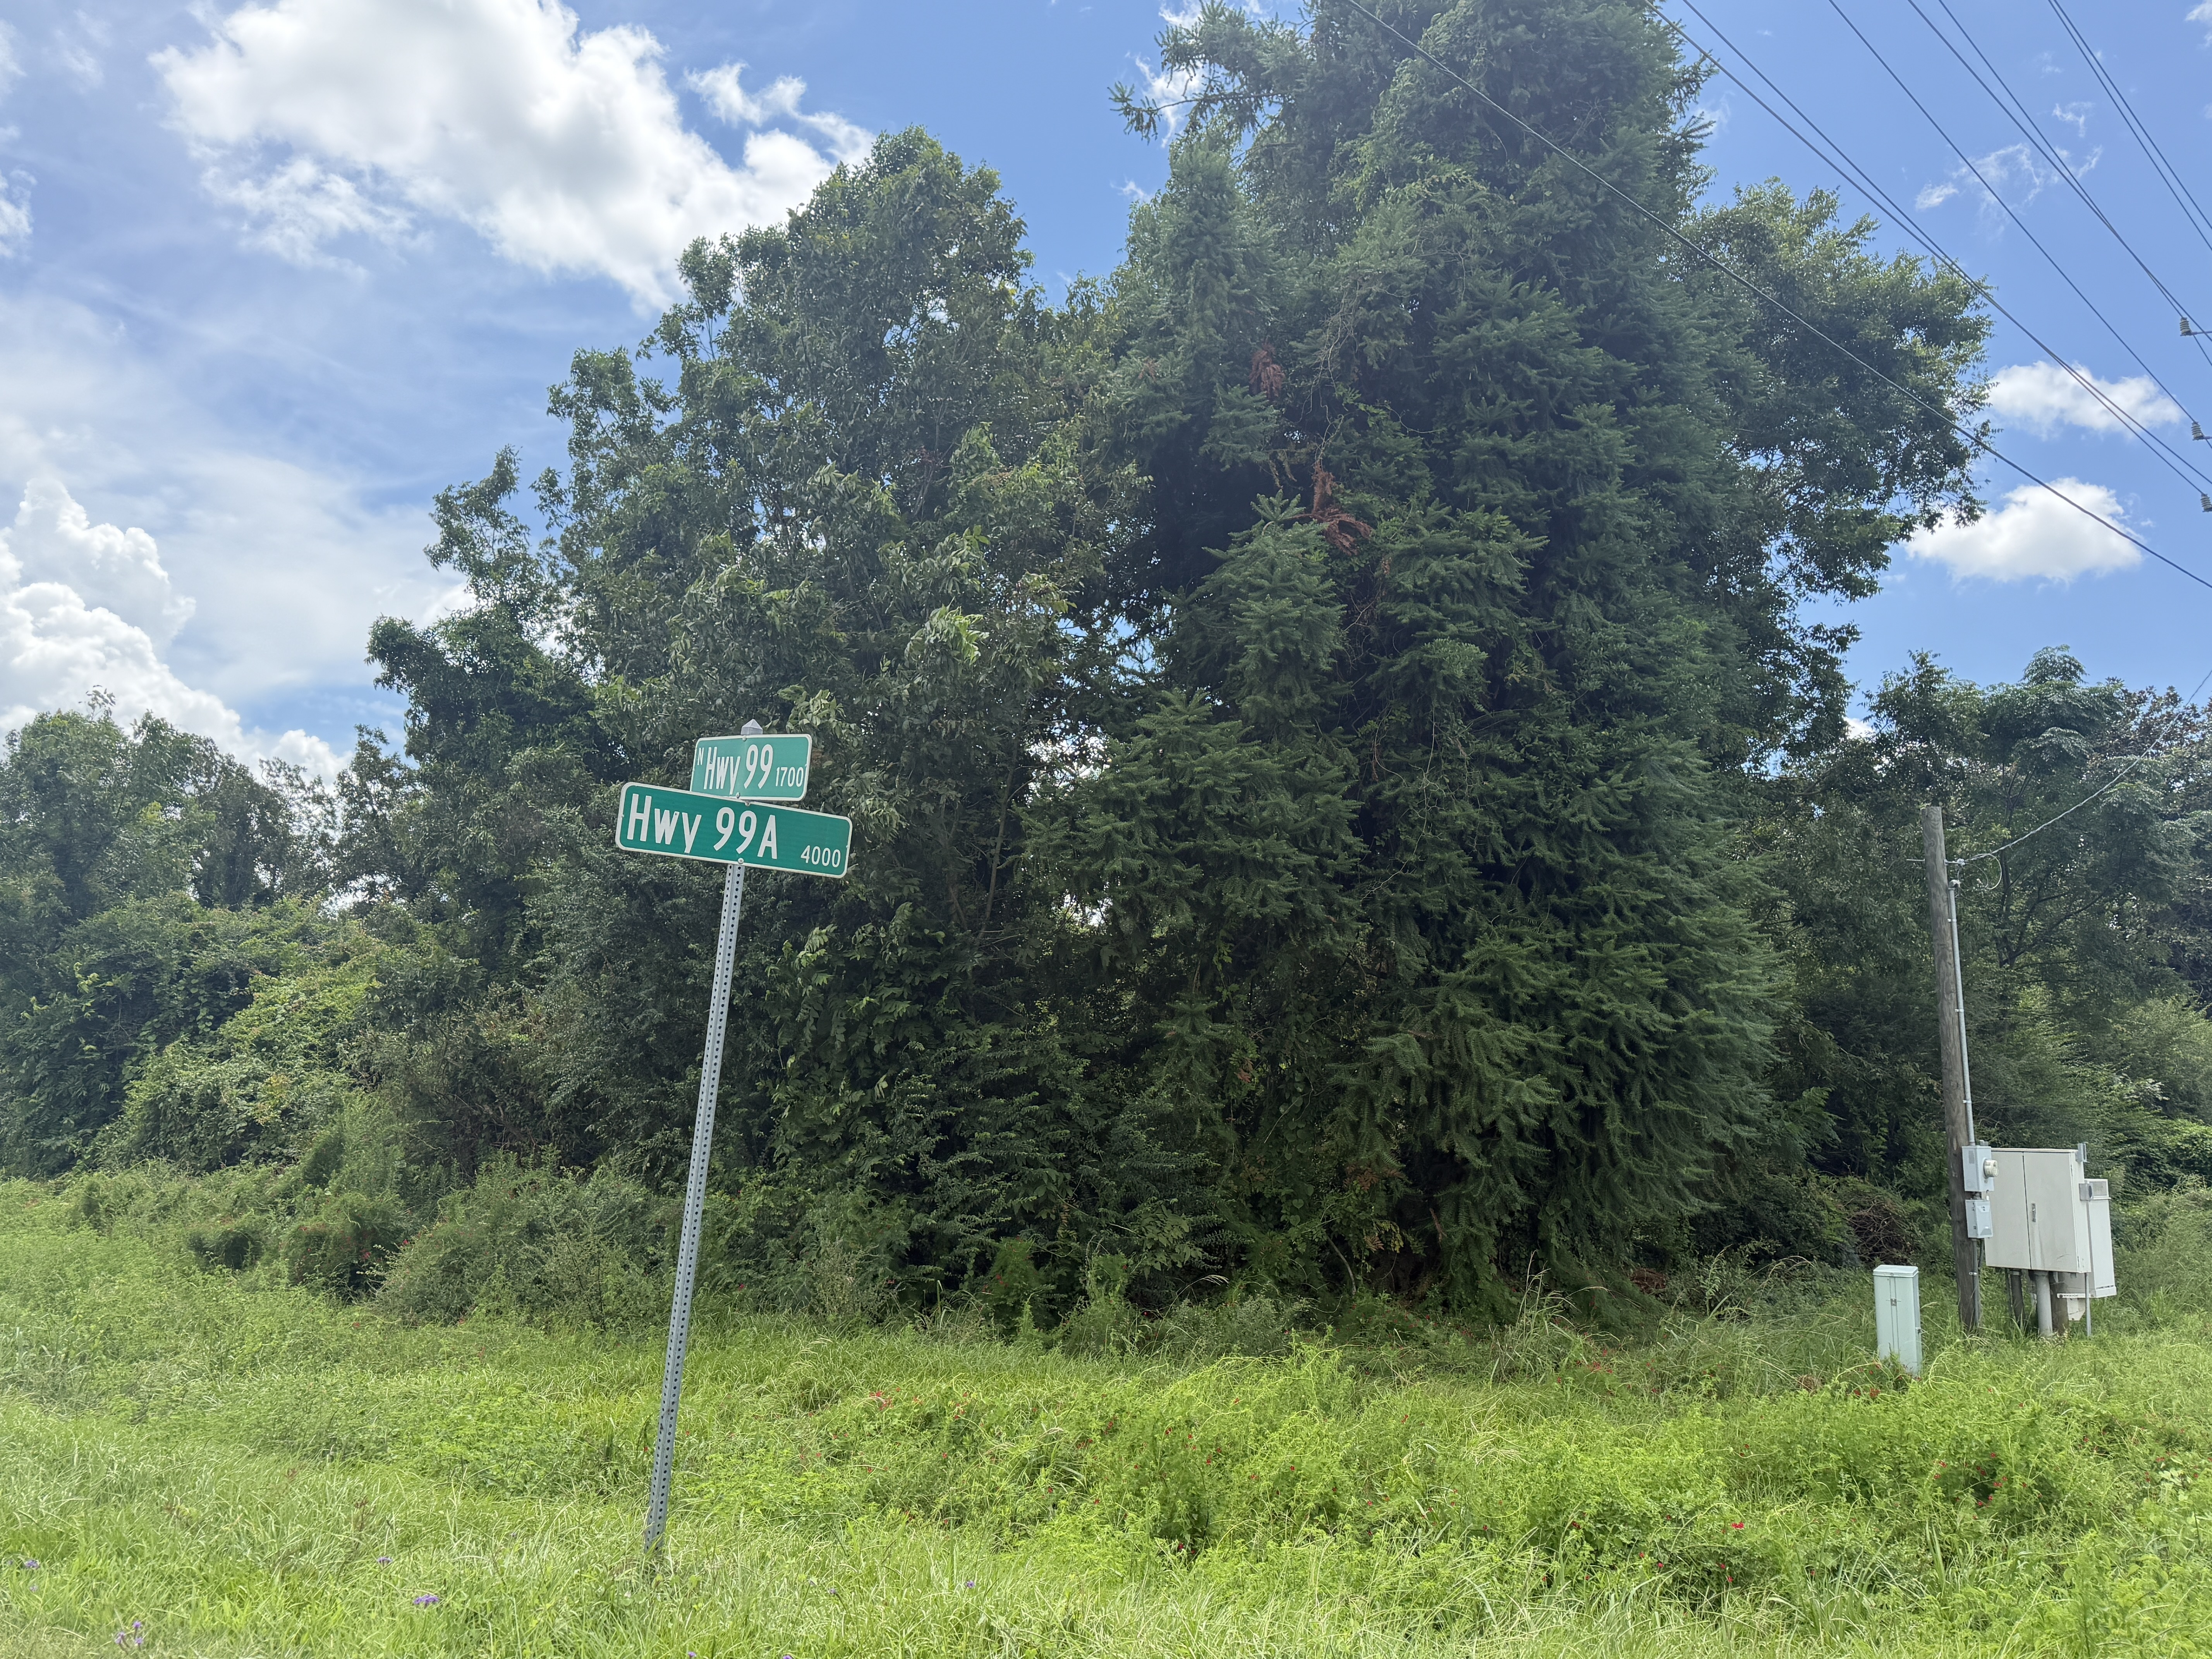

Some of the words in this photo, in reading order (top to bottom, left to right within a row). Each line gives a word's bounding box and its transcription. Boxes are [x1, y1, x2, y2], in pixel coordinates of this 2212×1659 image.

[697, 747, 704, 766] N
[704, 747, 740, 795] Hwy
[744, 744, 773, 789] 99
[775, 766, 803, 787] 1700
[627, 793, 702, 853] Hwy
[713, 807, 777, 859] 99A
[800, 845, 841, 867] 4000
